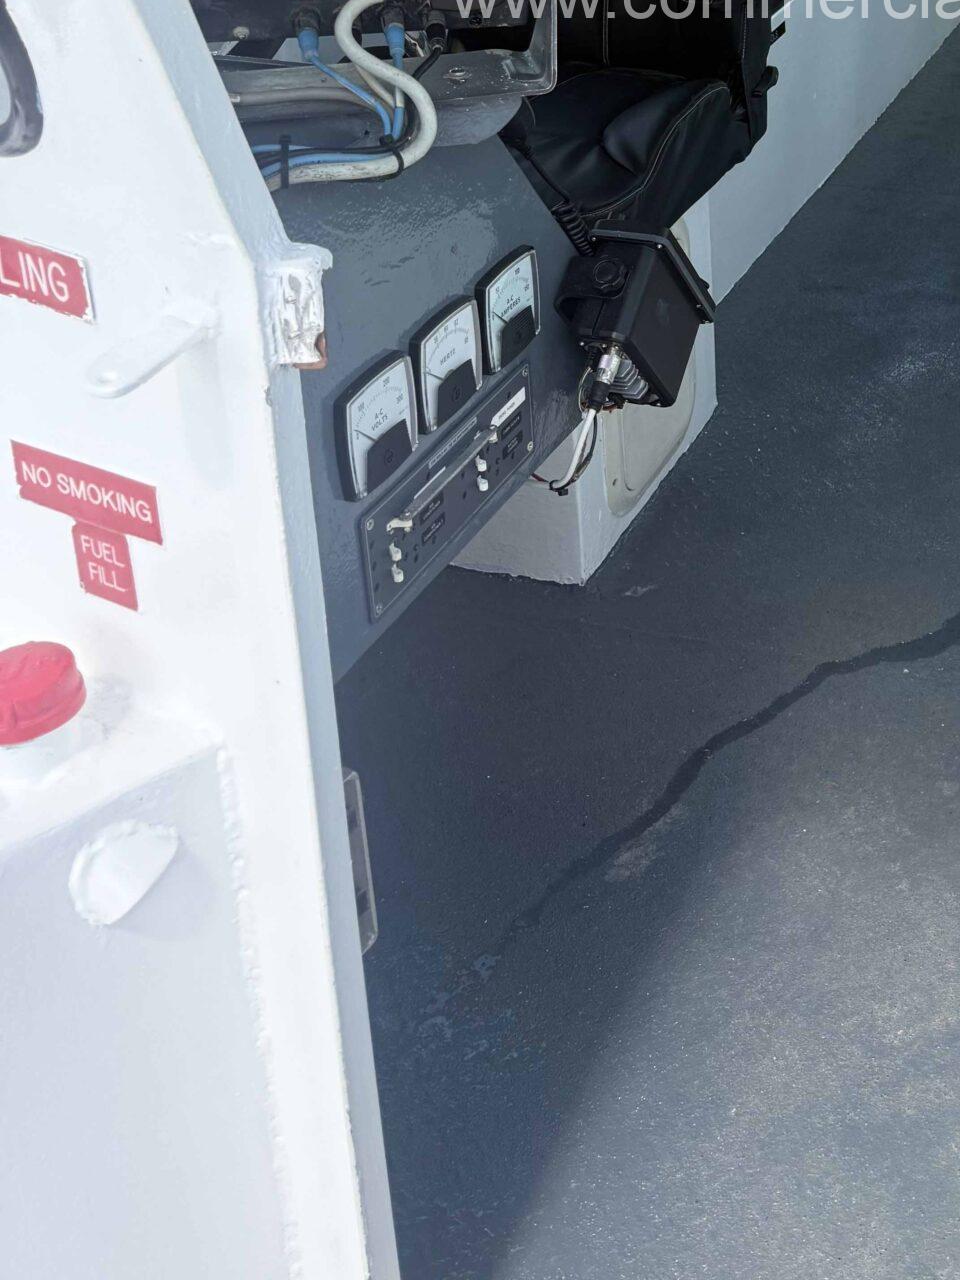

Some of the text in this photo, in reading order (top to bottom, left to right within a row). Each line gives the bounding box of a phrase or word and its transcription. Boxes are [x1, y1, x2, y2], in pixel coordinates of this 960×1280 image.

[439, 348, 456, 366] HERTZ
[370, 414, 389, 432] VOLTS
[21, 460, 153, 524] NO SMOKING
[80, 534, 126, 568] FUEL
[88, 561, 128, 593] FILL
